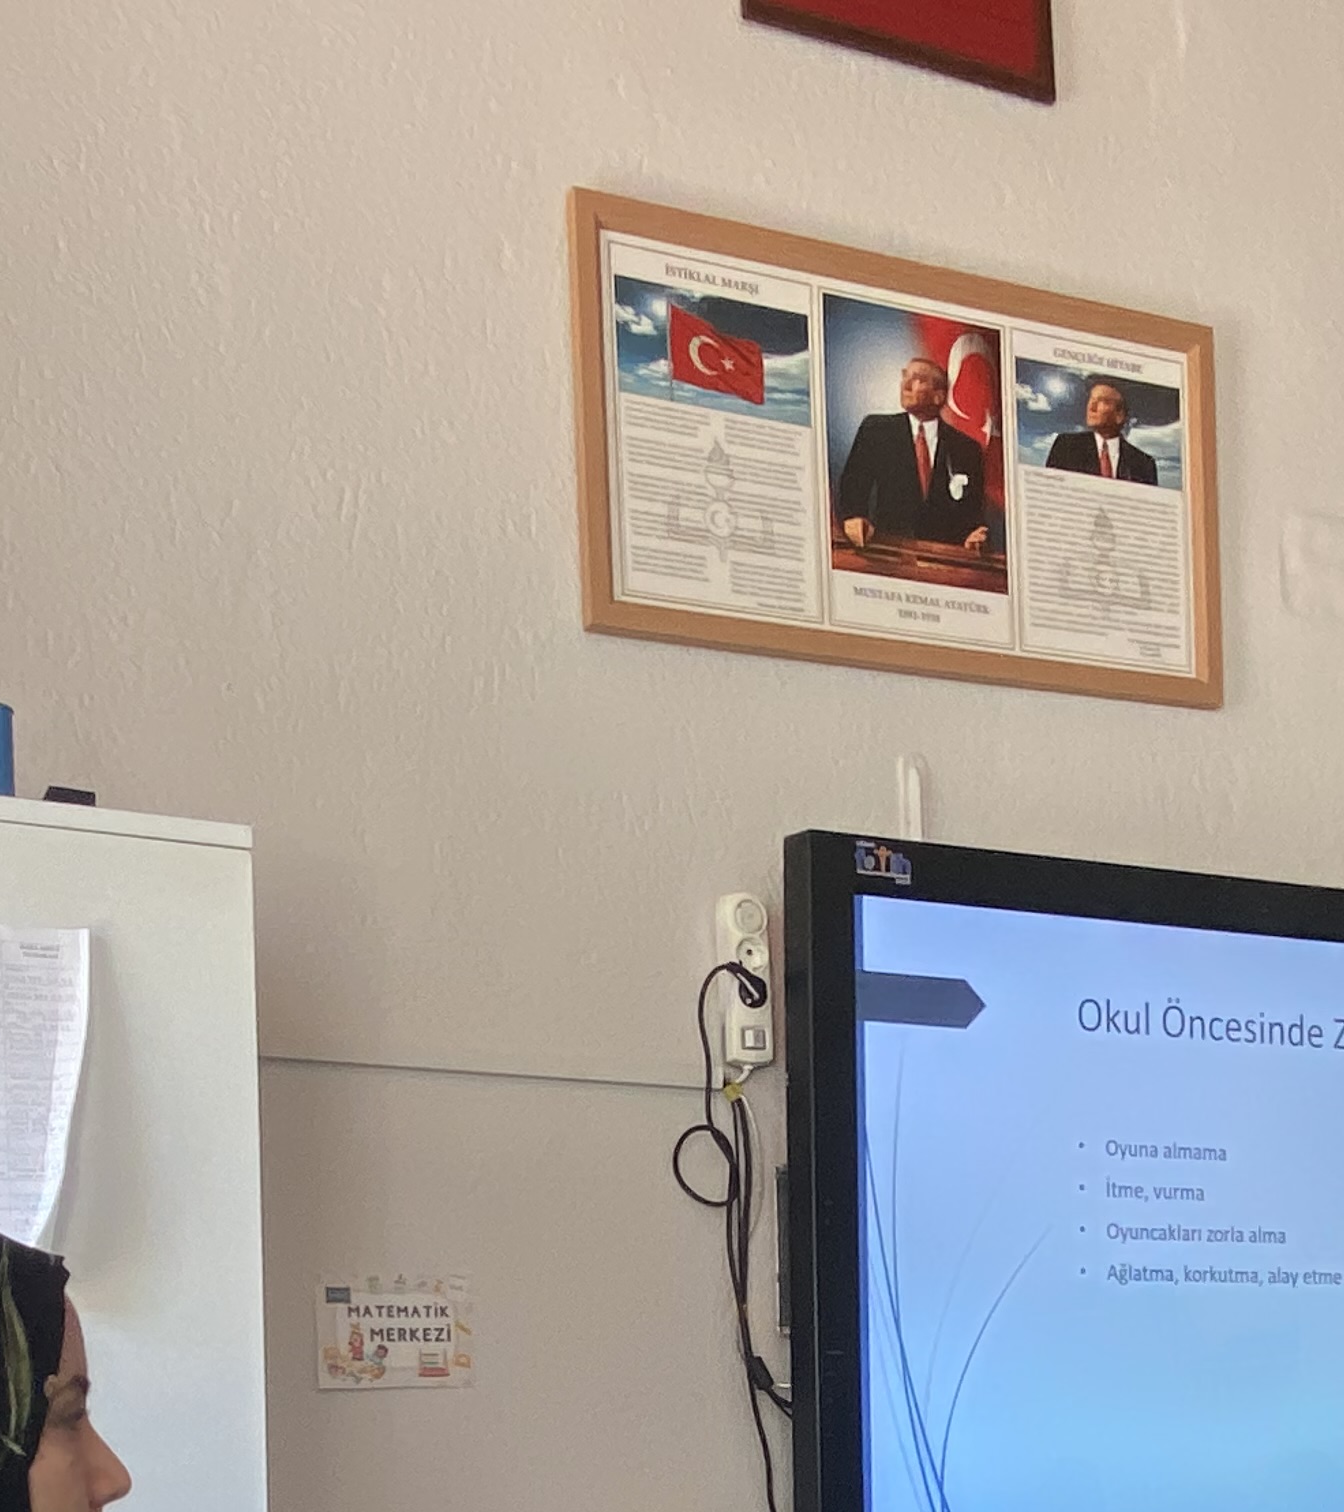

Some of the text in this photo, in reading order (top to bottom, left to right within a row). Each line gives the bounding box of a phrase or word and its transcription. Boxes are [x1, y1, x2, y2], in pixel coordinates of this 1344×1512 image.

[1077, 998, 1151, 1036] Okul
[1162, 997, 1324, 1049] Öncesinde
[1106, 1139, 1227, 1162] Oyuna almama
[1106, 1176, 1205, 1202] İtme, vurma
[1106, 1222, 1287, 1245] Oyuncakları zorla alma
[1107, 1263, 1180, 1286] Ağlatma,
[1183, 1264, 1264, 1287] korkutma,
[1267, 1266, 1299, 1288] alay
[1302, 1270, 1343, 1286] etme
[347, 1301, 449, 1319] MATEMATİK
[369, 1324, 452, 1342] MERKEZİ
